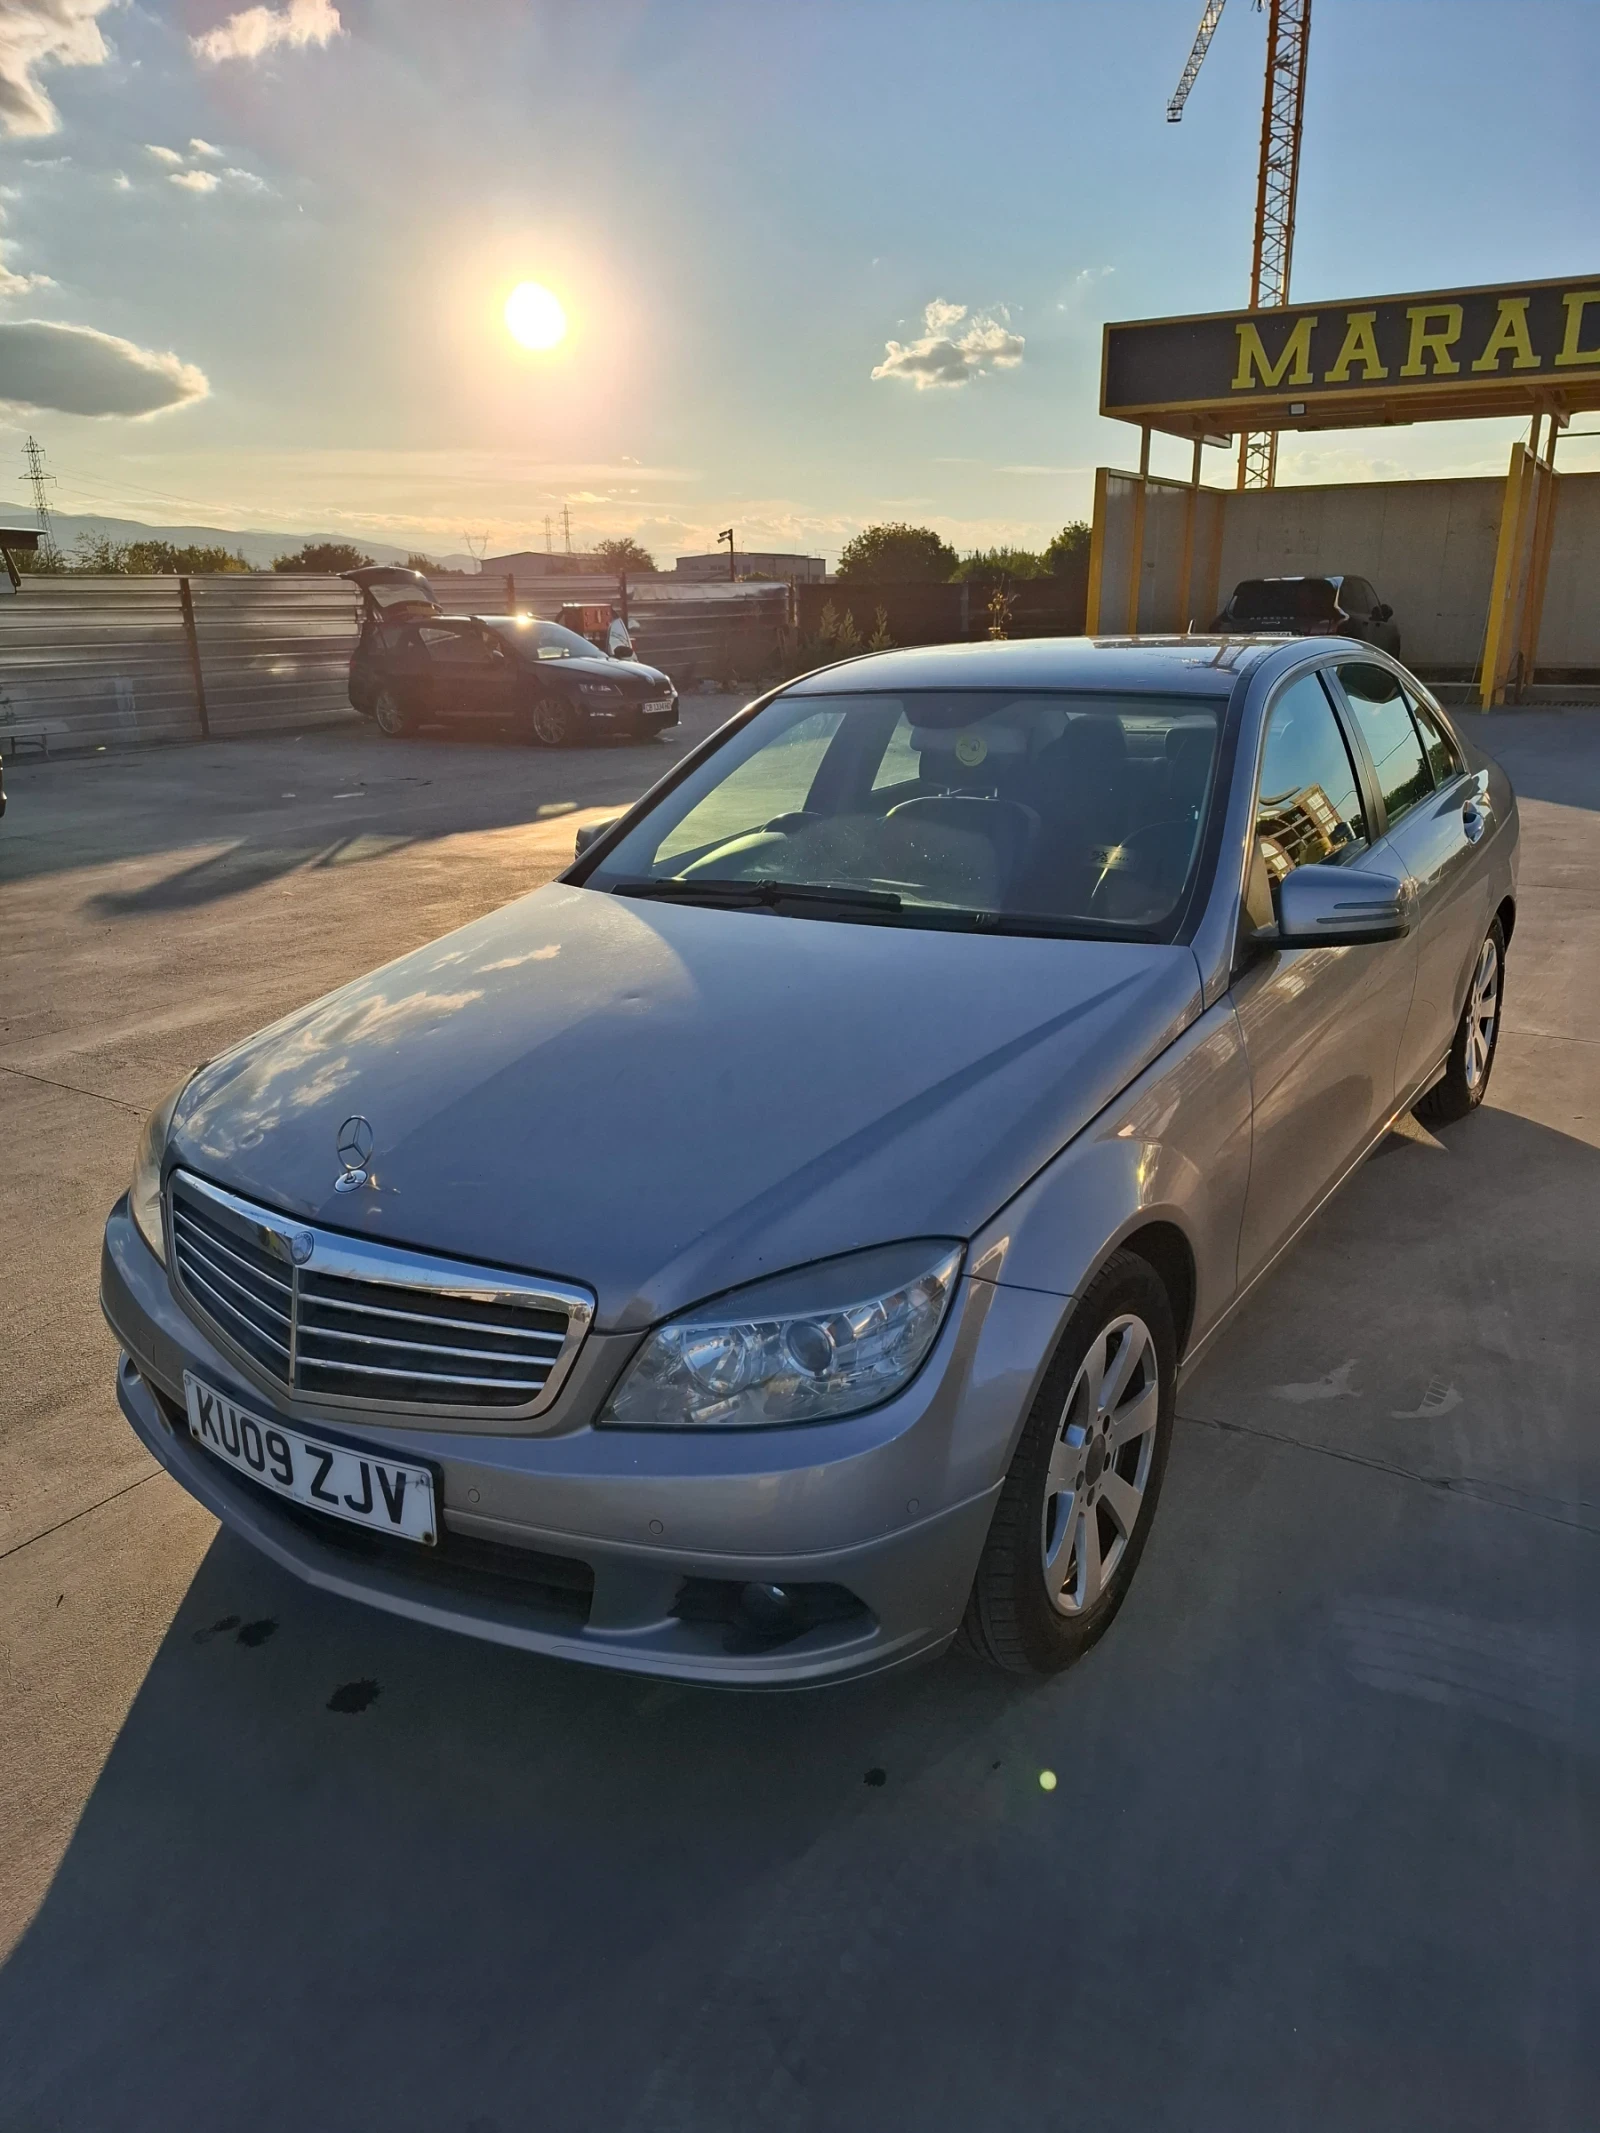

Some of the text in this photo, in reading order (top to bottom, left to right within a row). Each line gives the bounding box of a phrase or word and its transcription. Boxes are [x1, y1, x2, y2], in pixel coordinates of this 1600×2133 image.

[1231, 291, 1600, 389] MARAD
[195, 1385, 407, 1525] KU09 ZJV
